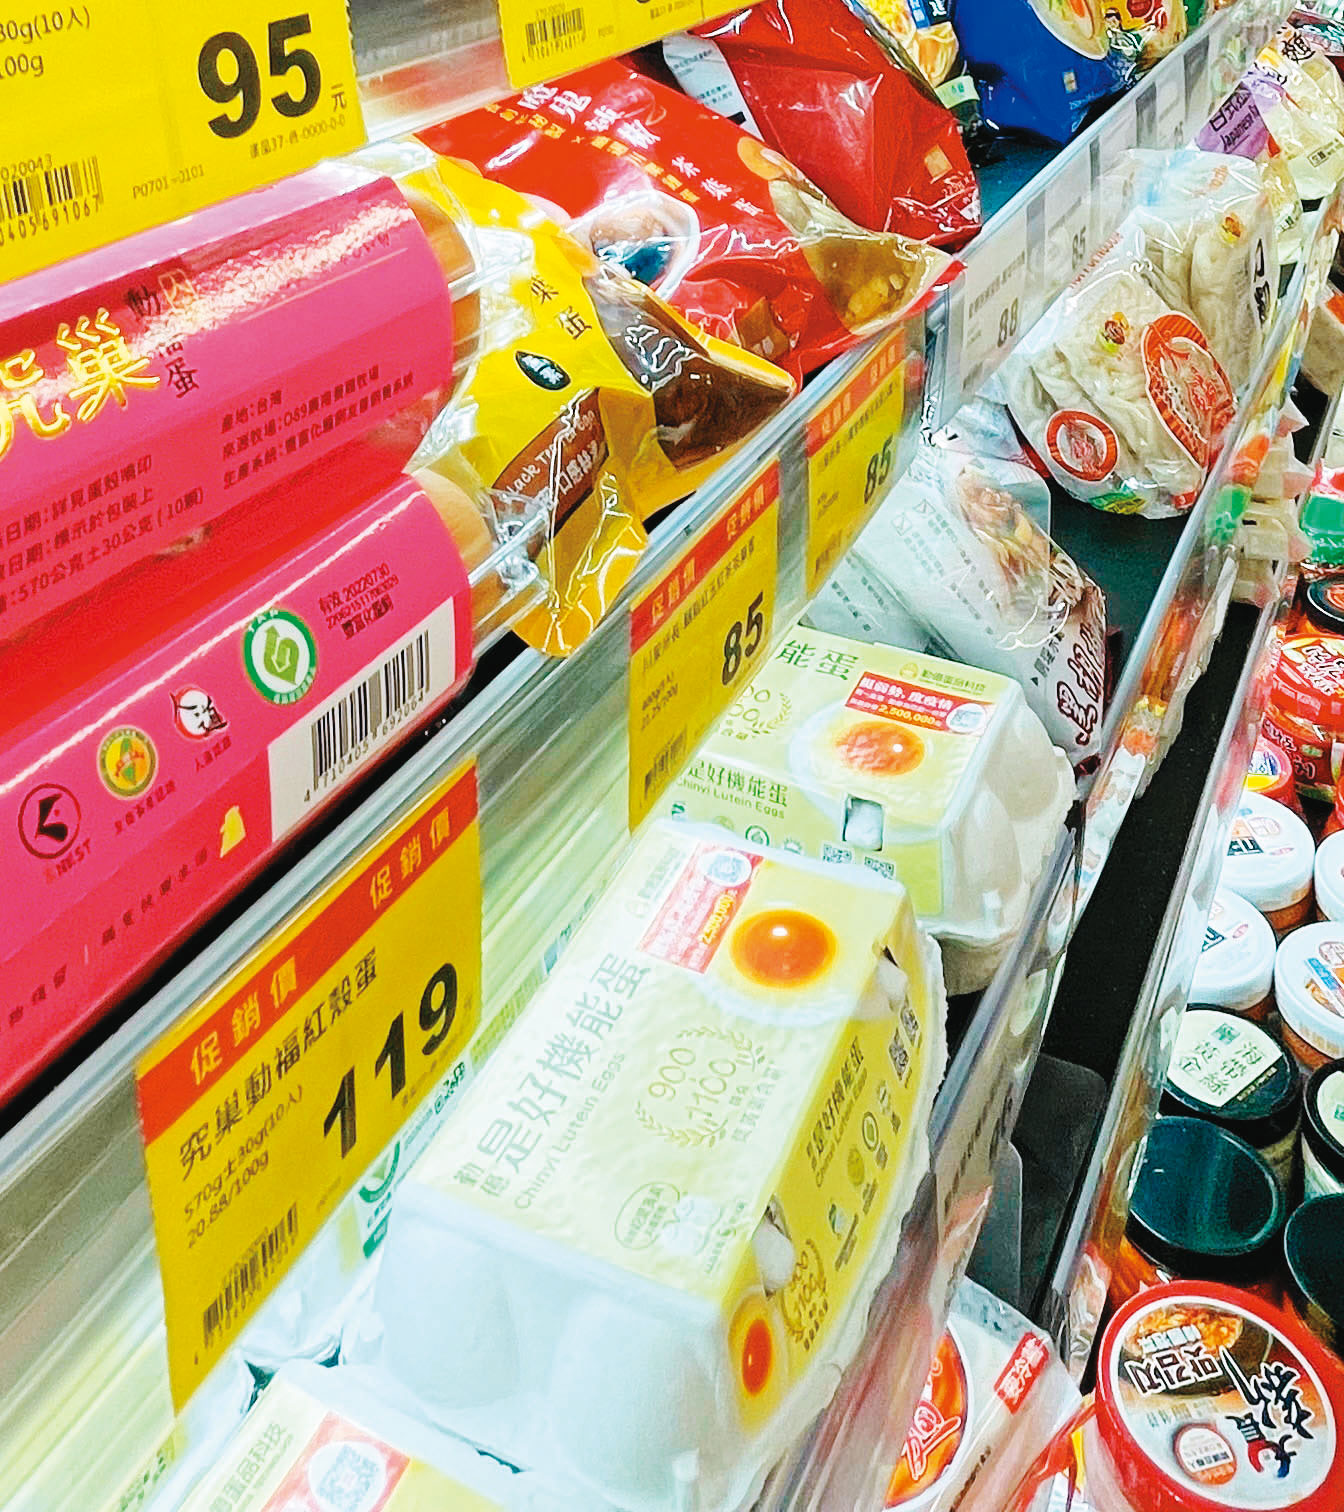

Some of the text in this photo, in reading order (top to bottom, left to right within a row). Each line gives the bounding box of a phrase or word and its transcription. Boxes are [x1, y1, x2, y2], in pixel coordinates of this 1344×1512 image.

[197, 13, 348, 139] 95 元
[997, 297, 1019, 348] 88
[864, 433, 894, 505] 85
[722, 590, 764, 686] 85
[323, 741, 369, 788] 710405
[713, 787, 752, 808] Lutein
[755, 801, 785, 821] Eggs
[368, 808, 453, 909] 促銷價
[179, 946, 377, 1181] 究巢動福紅殼蛋
[190, 957, 297, 1085] 促銷價
[324, 962, 457, 1160] 119
[478, 953, 651, 1174] 是好機能蛋
[648, 1048, 696, 1101] 900
[689, 1059, 737, 1123] 1100
[514, 1051, 626, 1209] Chinyi Lutein Eggs
[1125, 1345, 1220, 1395] 맛김치
